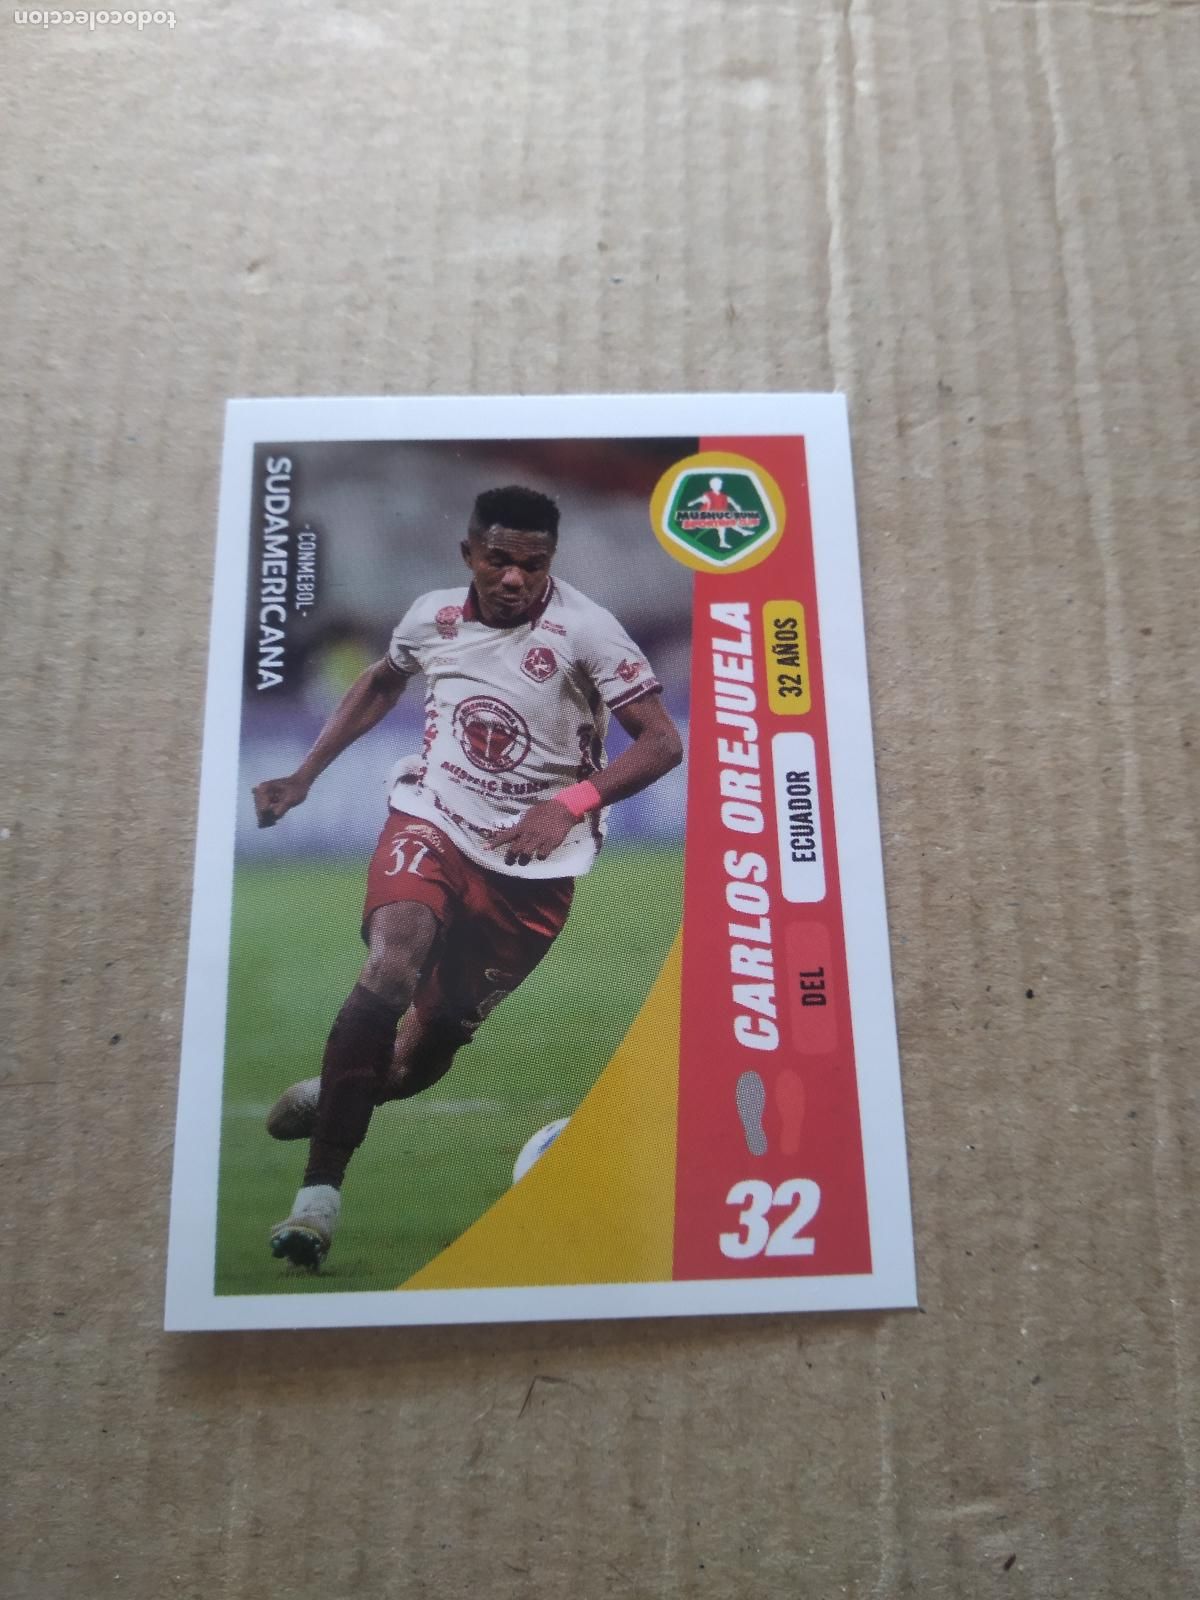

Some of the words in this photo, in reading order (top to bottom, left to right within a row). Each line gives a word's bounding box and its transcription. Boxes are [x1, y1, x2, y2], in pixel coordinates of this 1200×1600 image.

[256, 456, 292, 691] SUDAMERICANA
[772, 617, 801, 667] AÑOS
[710, 602, 765, 834] OREJUELA
[778, 674, 803, 698] 32
[786, 770, 816, 863] ECUADOR
[723, 849, 780, 1051] CARLOS
[800, 966, 827, 1006] DEL
[719, 1179, 821, 1259] 32
